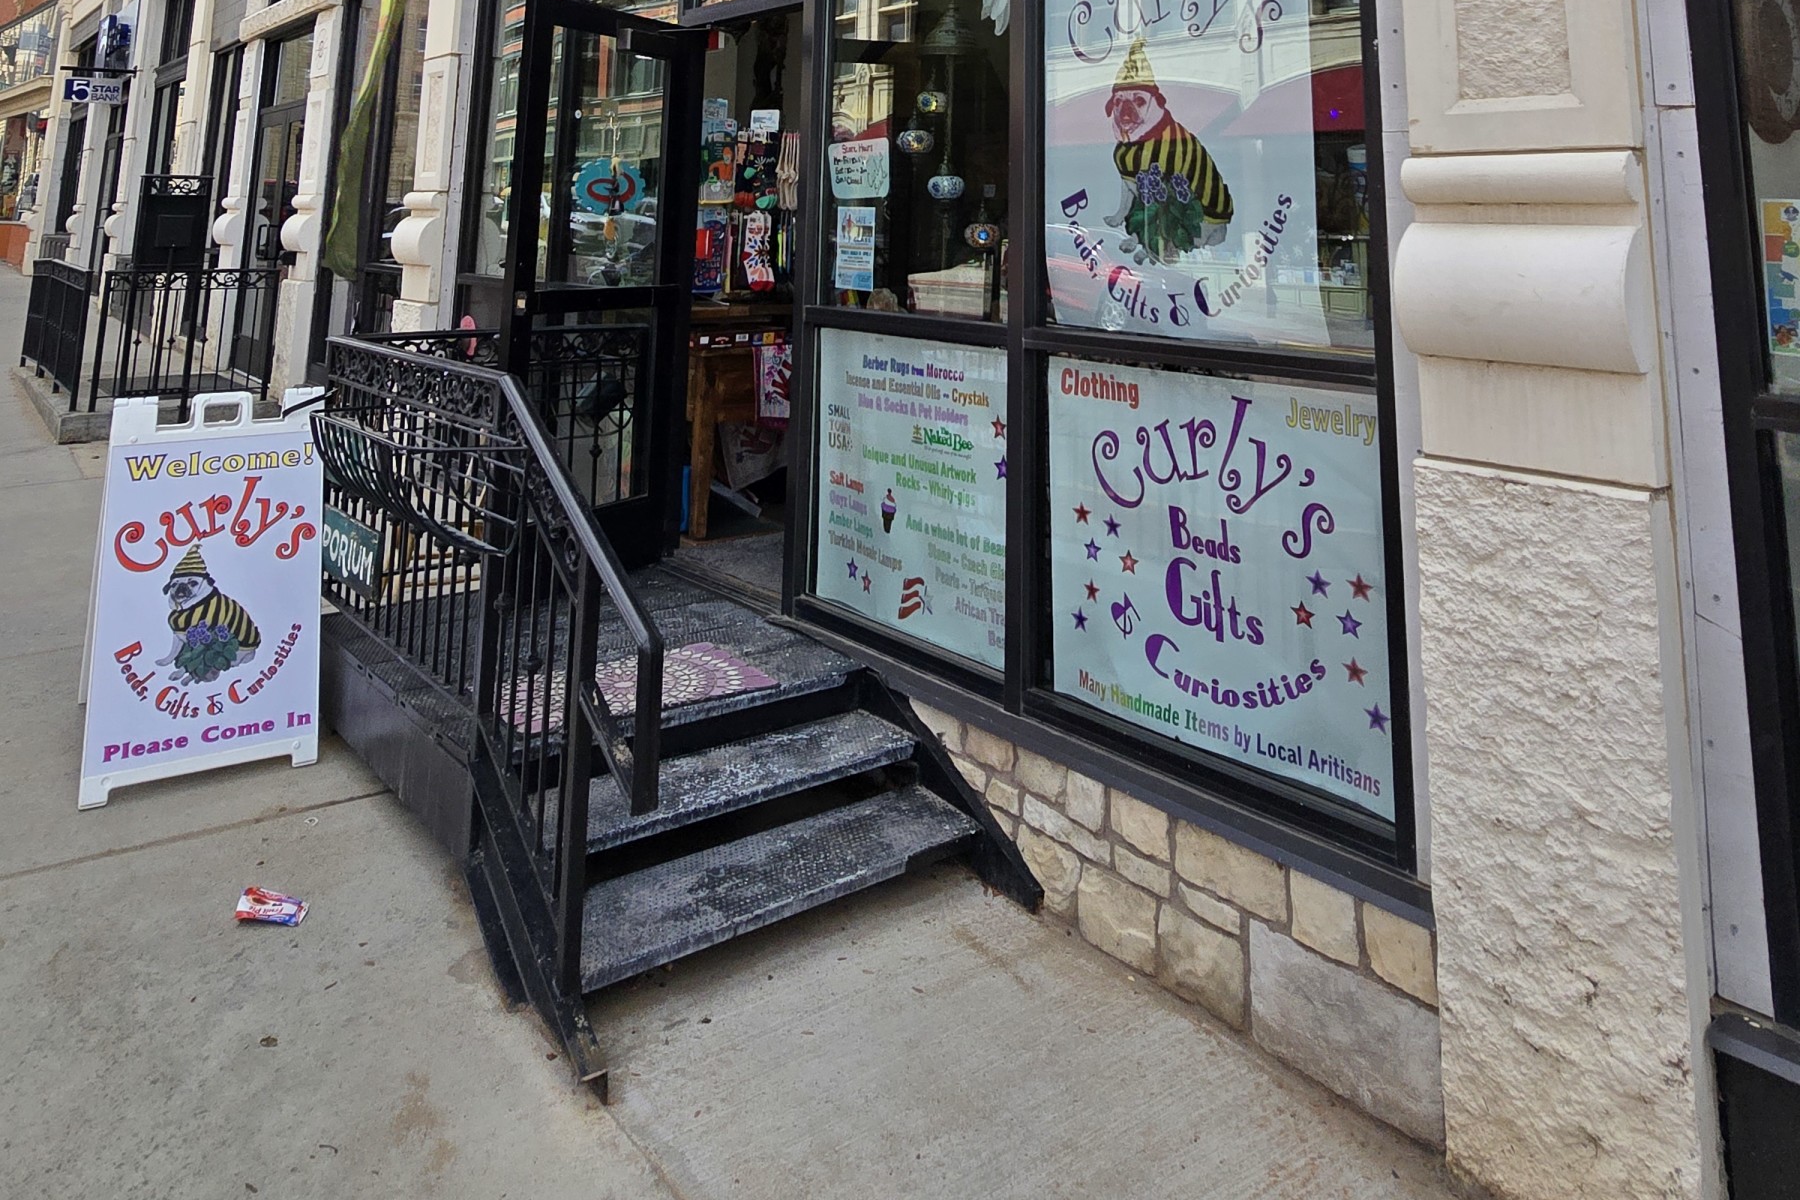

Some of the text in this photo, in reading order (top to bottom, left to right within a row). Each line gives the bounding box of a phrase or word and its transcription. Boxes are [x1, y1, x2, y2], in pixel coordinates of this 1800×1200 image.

[71, 80, 90, 102] 5
[91, 85, 120, 93] STAR
[91, 93, 120, 102] BANK
[1060, 188, 1293, 327] Beads, Gifts & Curiosities
[862, 354, 888, 371] Berber
[890, 357, 910, 377] Rugs
[926, 363, 965, 382] Morocco
[845, 371, 870, 389] Incense
[872, 377, 886, 391] and
[889, 378, 924, 398] Essential
[925, 384, 940, 400] Oils
[951, 388, 989, 407] Crystals
[1060, 367, 1140, 410] Clothing
[828, 404, 850, 419] SMALL
[884, 396, 909, 416] Socks
[935, 406, 969, 426] Holders
[1285, 397, 1377, 446] Jewelry
[828, 432, 848, 451] USA
[923, 427, 975, 452] Naked Bee
[125, 442, 315, 482] Welcome!
[862, 444, 889, 465] Unique
[891, 453, 906, 467] and
[908, 455, 939, 475] Unusual
[940, 461, 976, 484] Artwork
[1092, 396, 1335, 559] Curly's
[845, 474, 864, 495] Lamps
[895, 472, 920, 492] Rocks
[929, 481, 976, 508] Whirly-gigs
[114, 476, 317, 572] Curly's
[849, 495, 868, 515] Lamps
[828, 511, 873, 539] Amber Lamps
[905, 514, 1005, 557] And a whole lot of Bea
[1168, 505, 1242, 565] Beads
[828, 530, 855, 553] Turkish
[878, 549, 902, 572] Lamps
[935, 567, 960, 589] Pearls
[955, 597, 987, 622] African
[1165, 557, 1265, 646] Gifts
[114, 622, 302, 719] Beads, Gifts & Curiosities
[1145, 634, 1326, 709] Curiosities
[102, 712, 312, 762] Please Come In
[1079, 669, 1381, 797] Many Handmade Items by Local Aritisans
